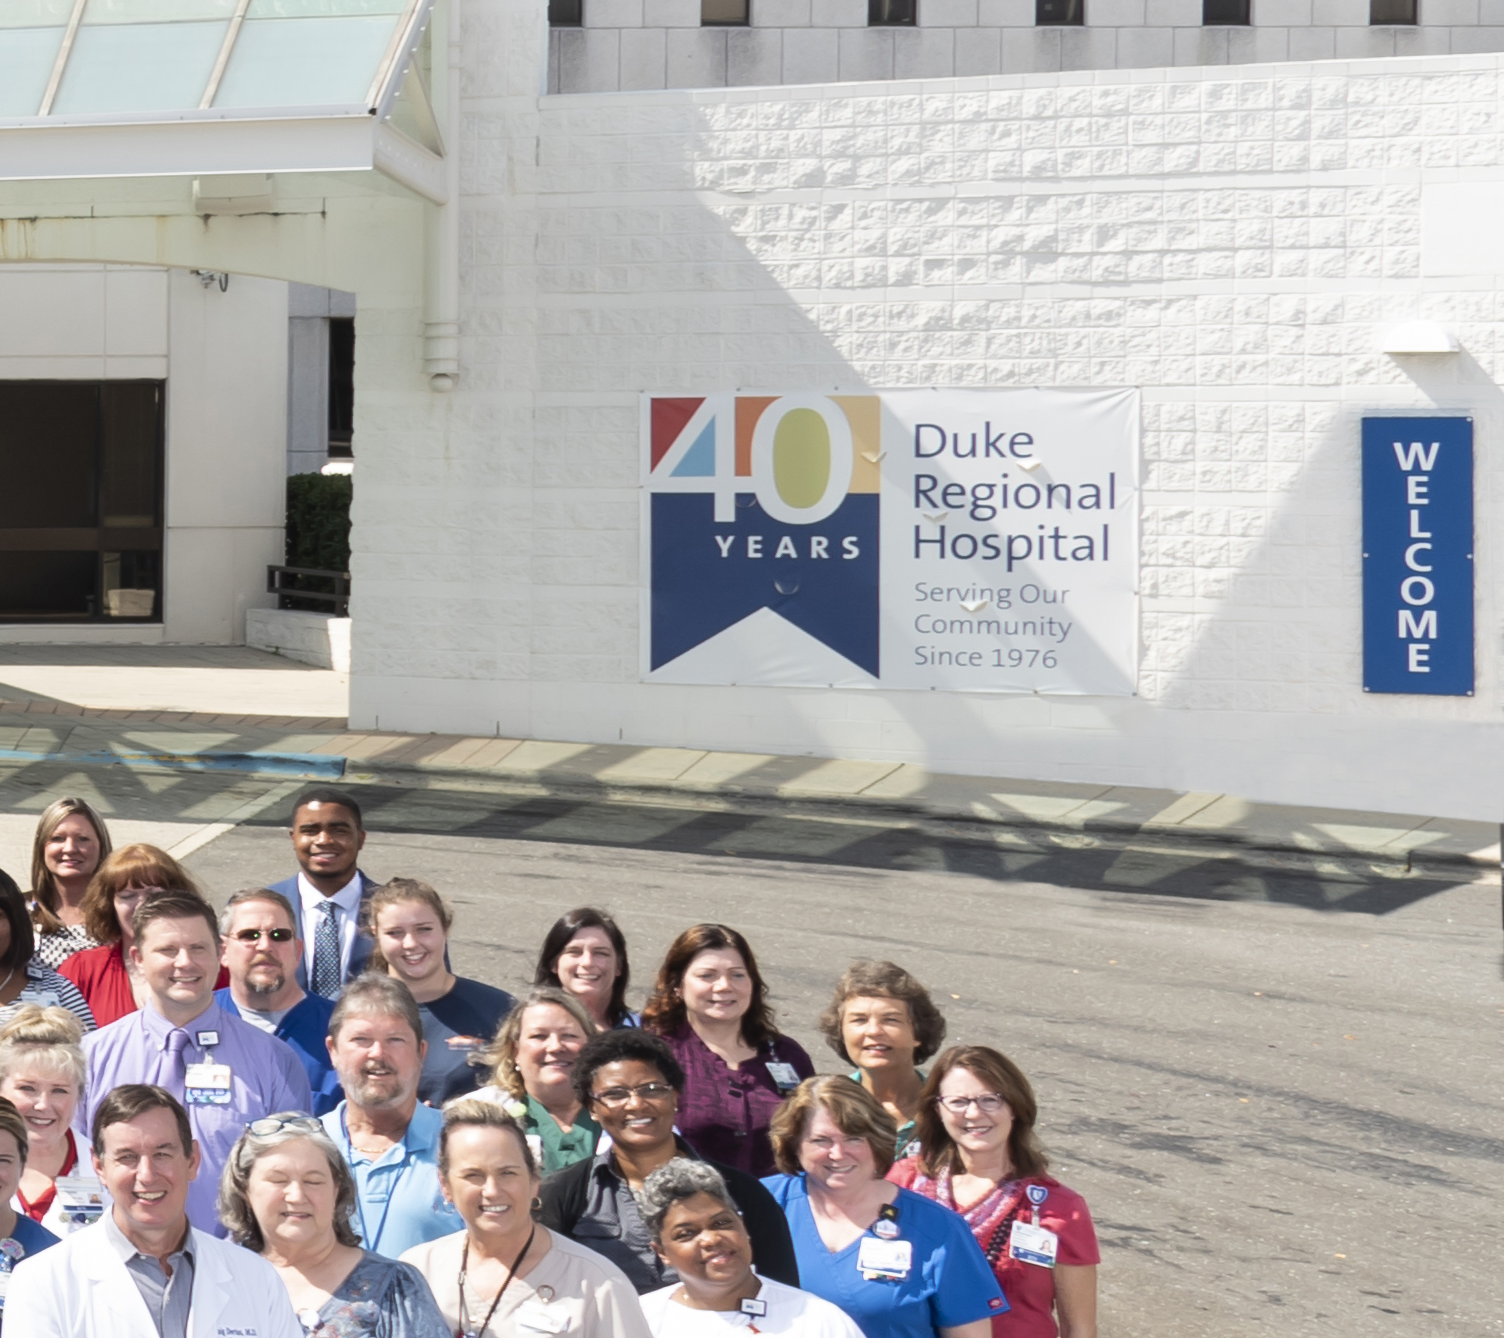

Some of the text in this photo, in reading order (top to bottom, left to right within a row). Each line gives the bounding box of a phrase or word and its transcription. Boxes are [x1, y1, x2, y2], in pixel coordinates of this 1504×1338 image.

[913, 421, 1035, 459] Duke
[650, 393, 854, 526] 40
[913, 472, 1115, 520] Regional
[714, 535, 860, 560] YEARS
[913, 523, 1109, 573] Hospital
[1392, 442, 1440, 673] WELCOME
[914, 582, 1069, 610] Serving Our
[913, 613, 1073, 642] Community
[914, 645, 1058, 669] Since 1976
